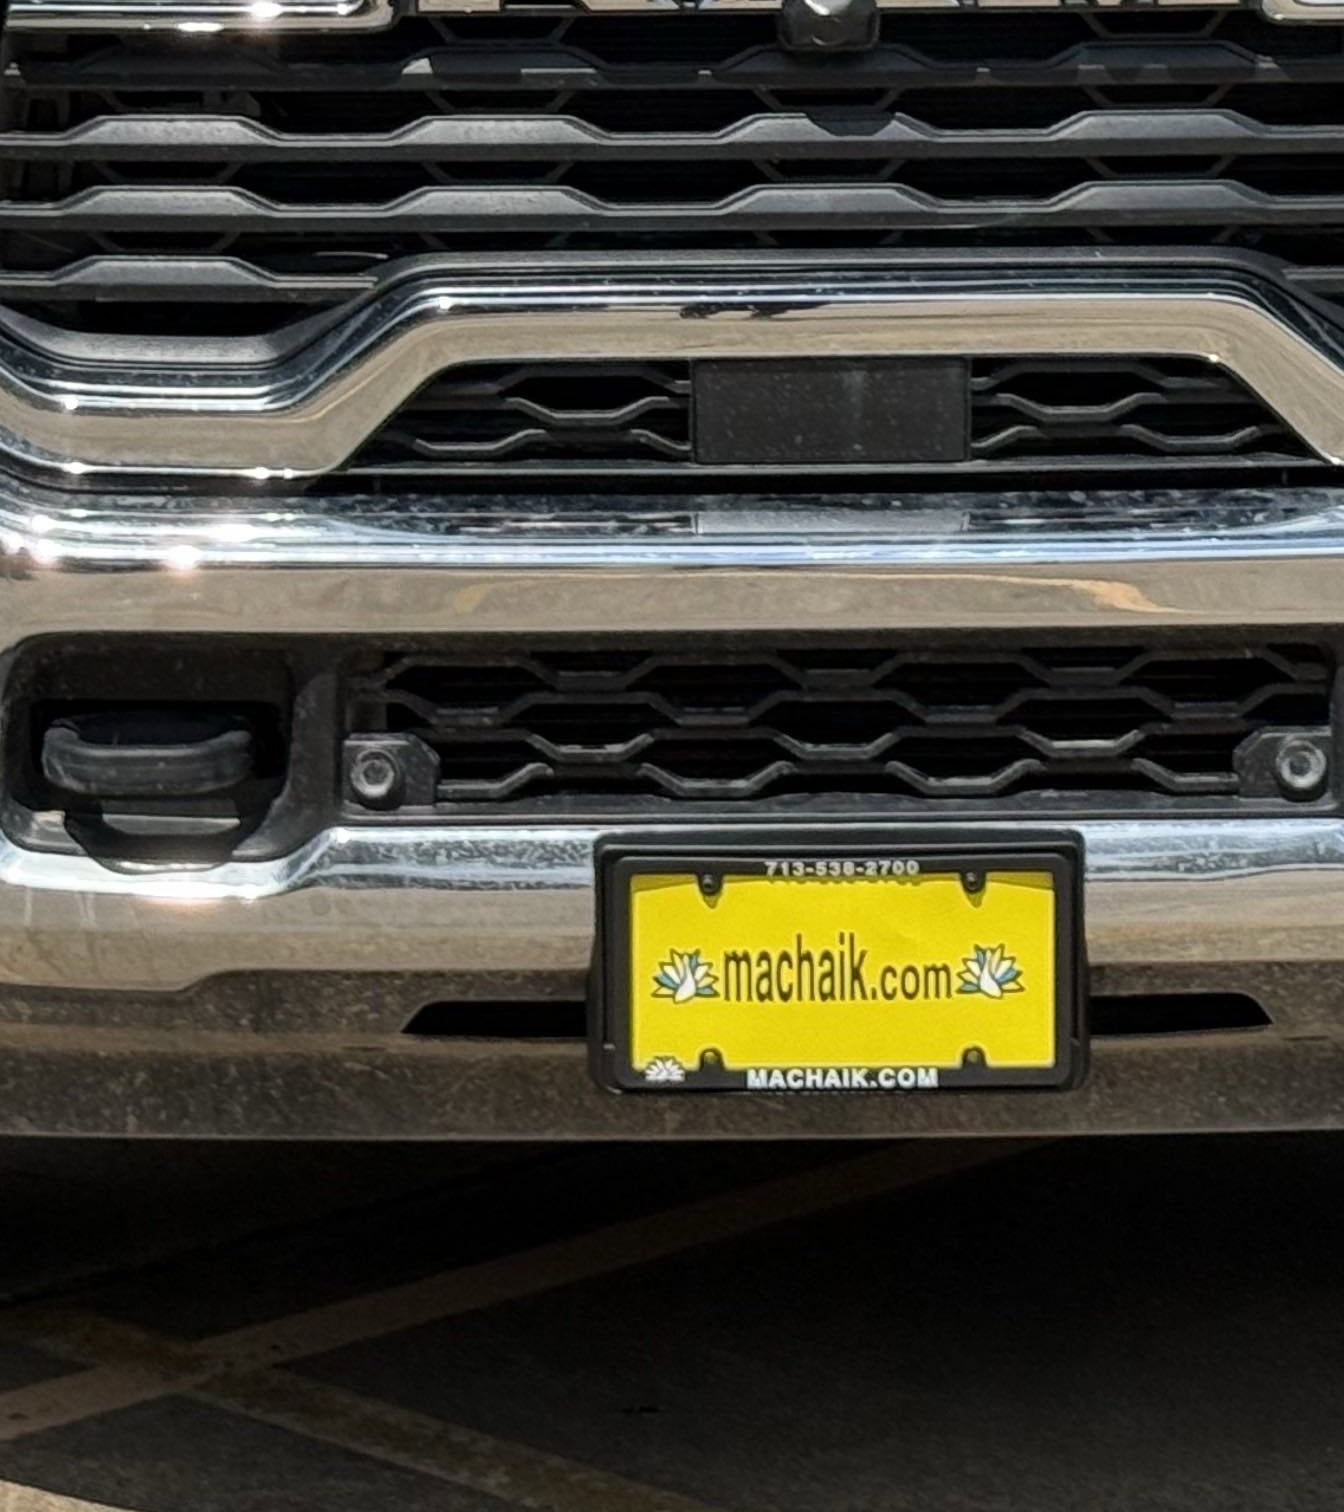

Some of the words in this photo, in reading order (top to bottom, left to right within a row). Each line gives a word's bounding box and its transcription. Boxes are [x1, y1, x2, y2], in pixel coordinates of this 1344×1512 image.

[763, 860, 920, 877] 713-538-2700
[723, 933, 953, 1003] machaik.com
[746, 1068, 939, 1089] MACHAIK.COM
